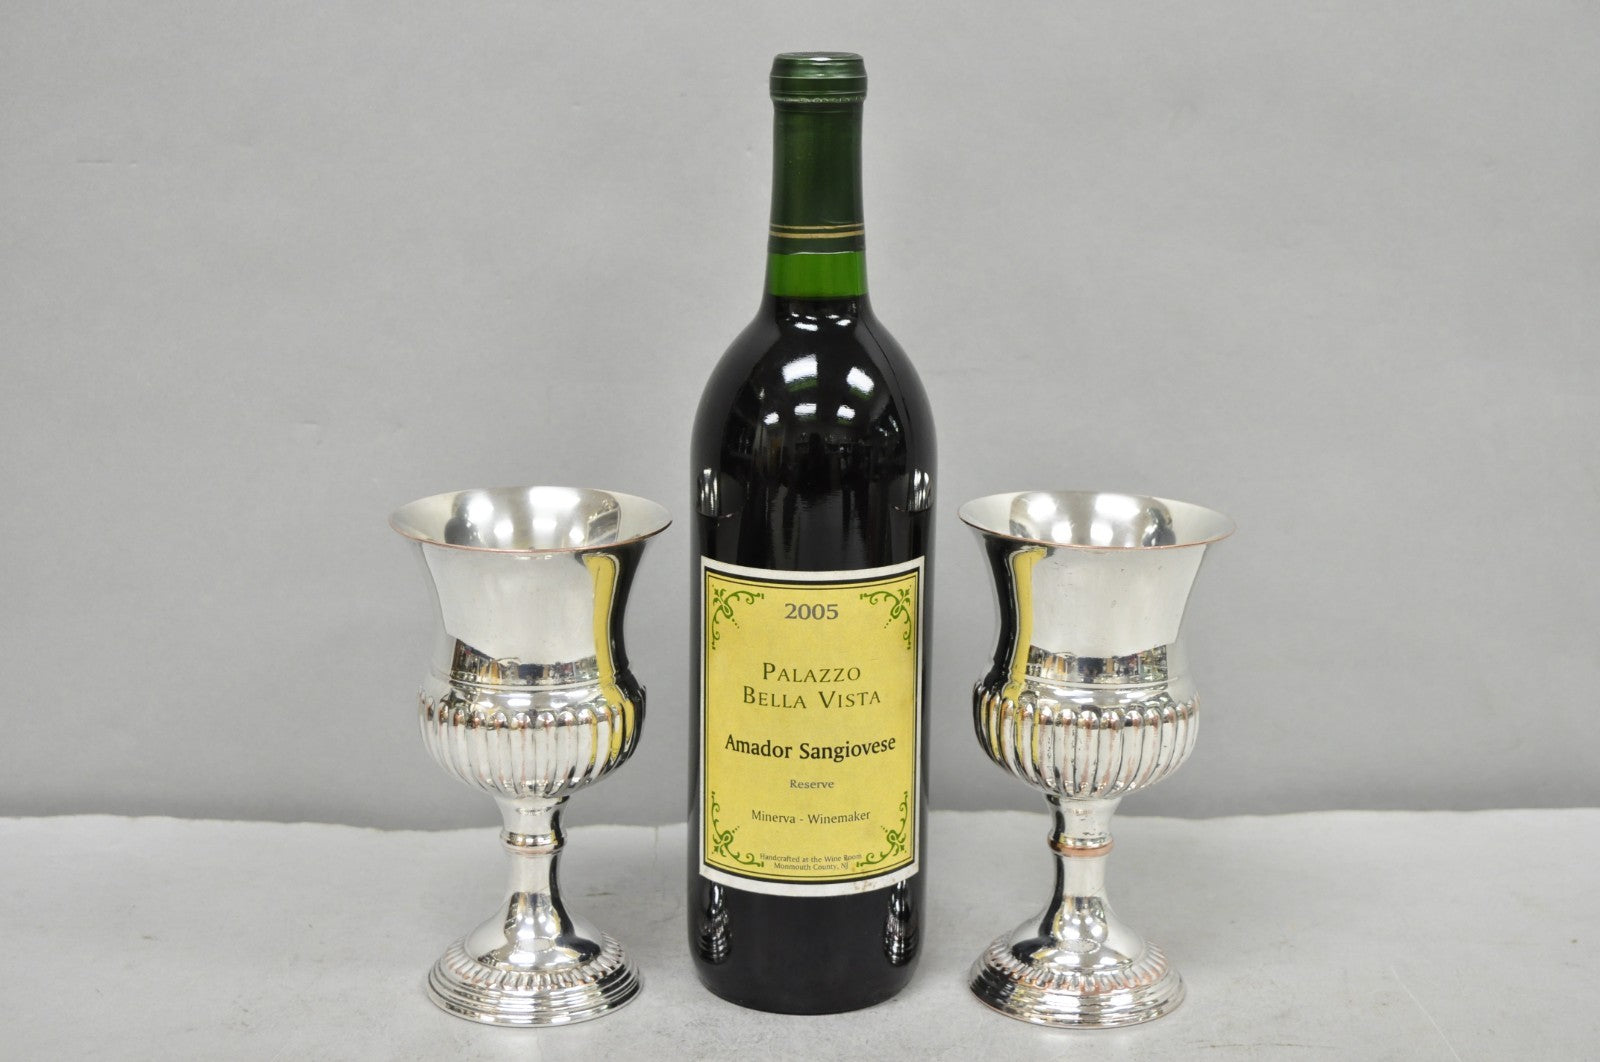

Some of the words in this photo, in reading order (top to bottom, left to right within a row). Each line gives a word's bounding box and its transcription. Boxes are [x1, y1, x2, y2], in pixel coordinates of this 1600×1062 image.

[784, 603, 839, 620] 2005
[762, 662, 861, 683] PALAZZO
[743, 685, 807, 709] BELLA
[818, 690, 881, 709] VISTA
[725, 734, 793, 759] Amador
[799, 737, 896, 763] Sangiovese
[789, 779, 835, 789] Reserve
[751, 809, 796, 824] Minerva
[807, 810, 871, 825] Winemaker
[760, 853, 800, 862] Handcrafted
[811, 855, 822, 863] the
[824, 855, 842, 863] Wine
[774, 862, 811, 871] Monmouth
[841, 862, 849, 870] NJ
